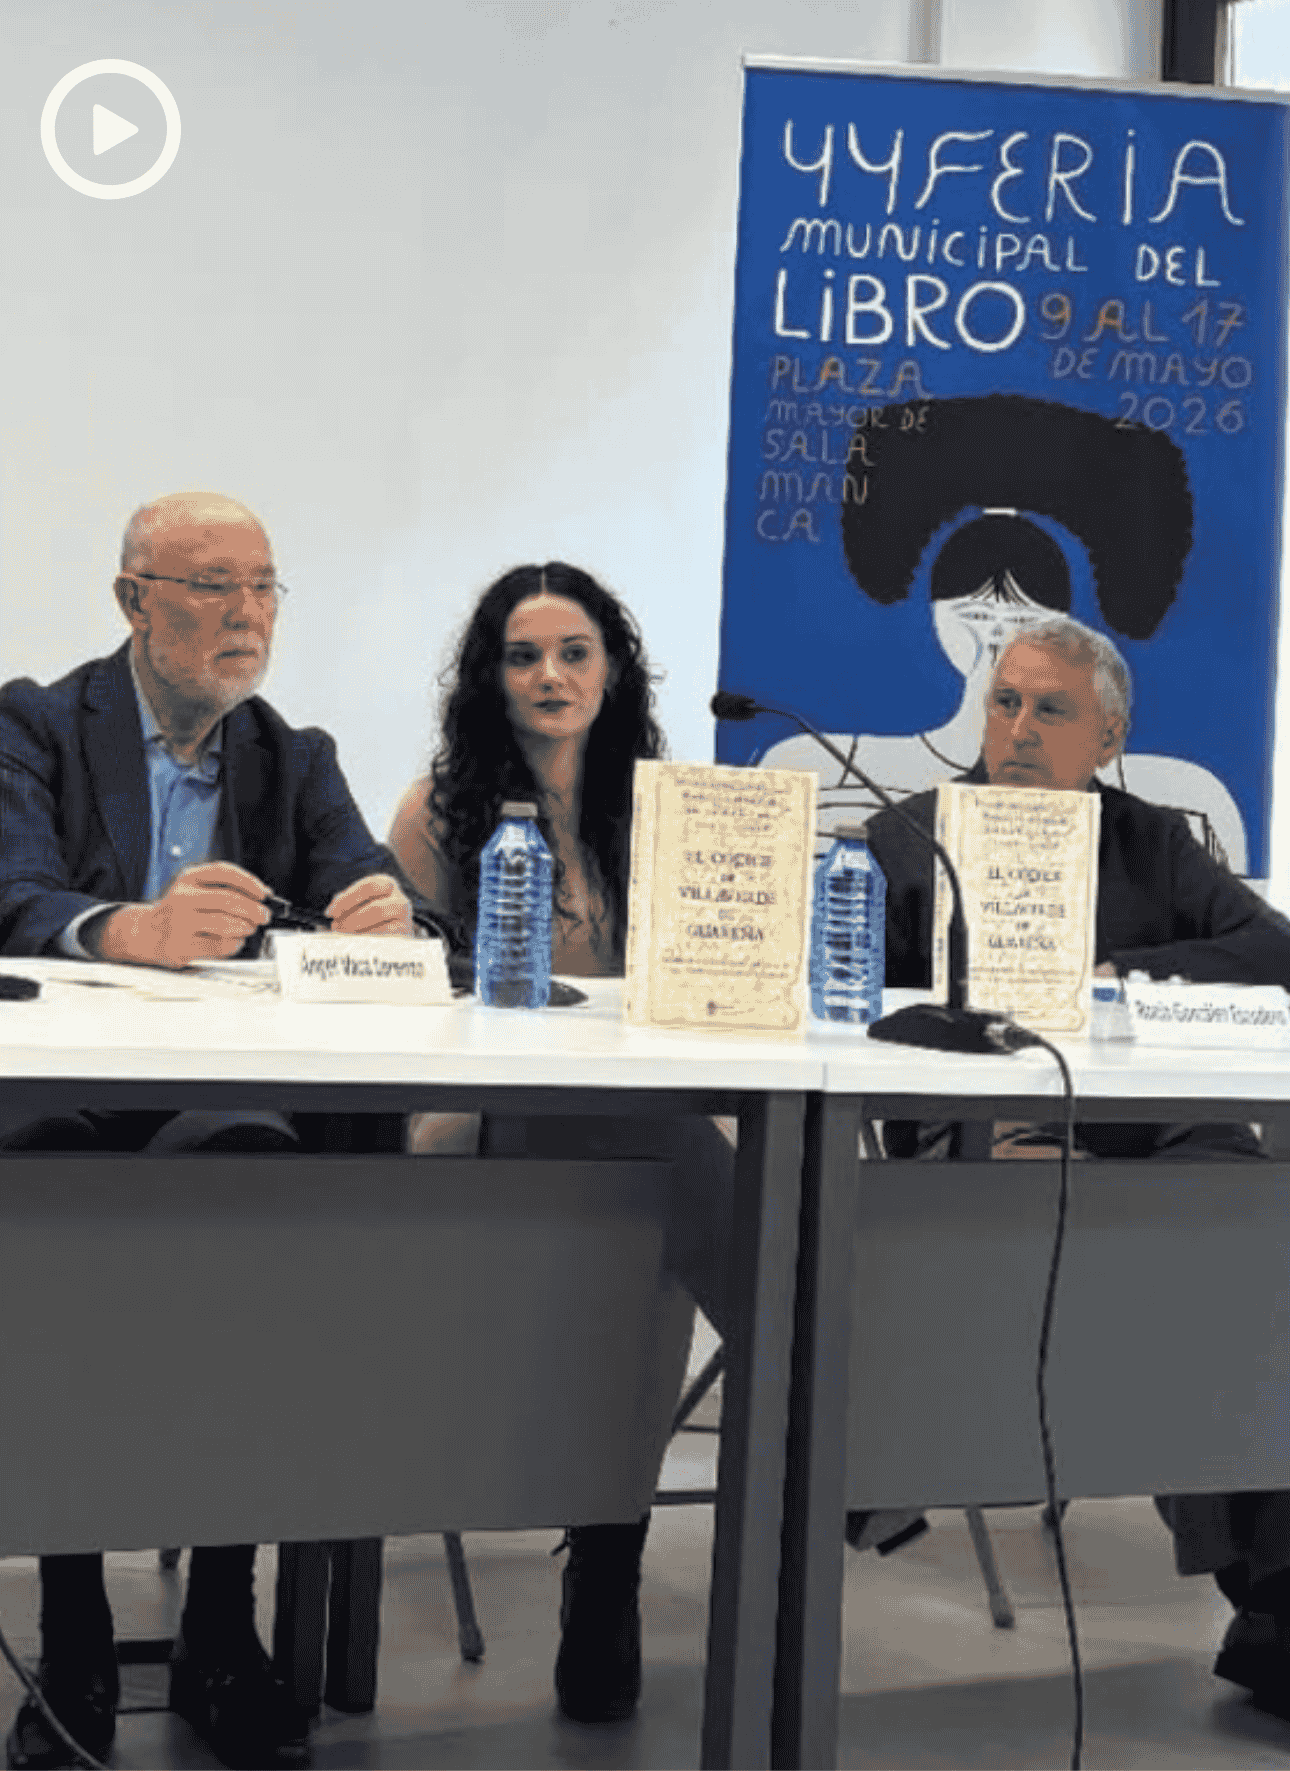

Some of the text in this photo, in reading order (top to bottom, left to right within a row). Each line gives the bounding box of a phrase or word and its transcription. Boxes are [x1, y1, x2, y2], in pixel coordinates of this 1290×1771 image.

[914, 126, 1246, 226] FERIA
[779, 216, 1221, 287] MUNICIPAL DEL
[774, 268, 1026, 353] LIBRO
[1041, 292, 1243, 347] 9 AL 17
[772, 356, 935, 400] PLAZA
[1053, 347, 1252, 389] DE MAYO
[764, 399, 930, 432] MAYOR DE
[1113, 391, 1244, 434] 2026
[763, 428, 875, 467] SALA
[759, 470, 868, 505] MAN
[756, 508, 821, 543] CA
